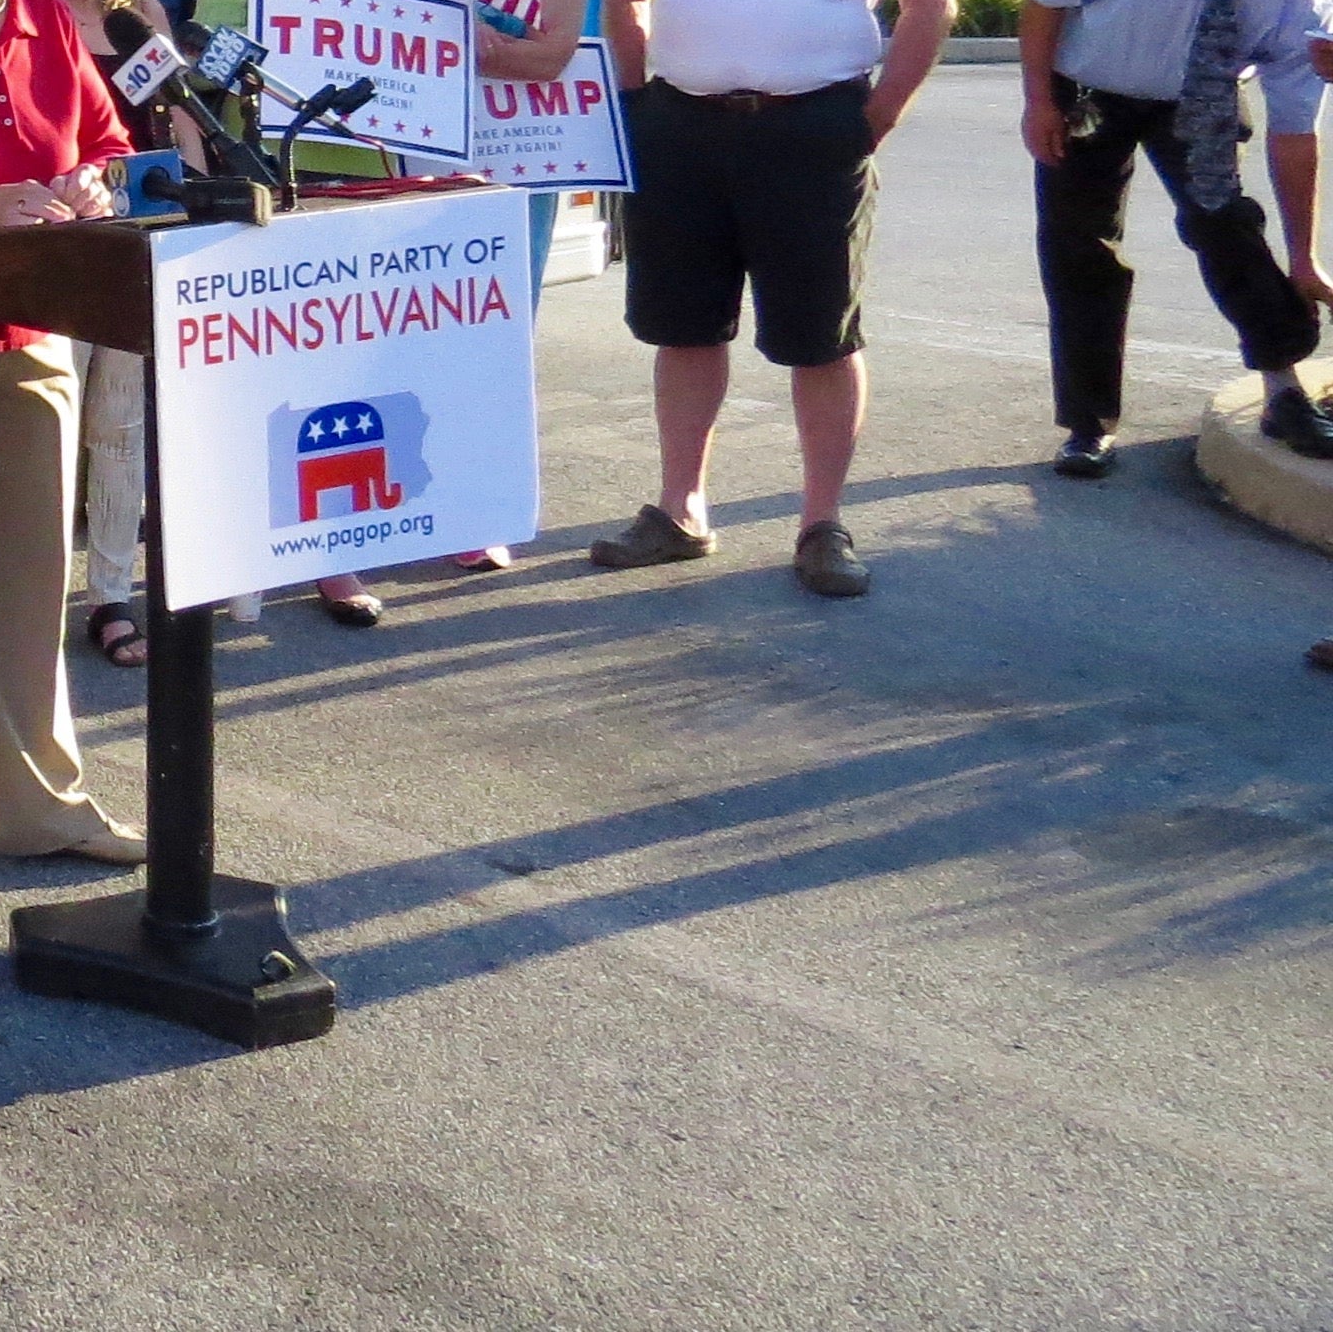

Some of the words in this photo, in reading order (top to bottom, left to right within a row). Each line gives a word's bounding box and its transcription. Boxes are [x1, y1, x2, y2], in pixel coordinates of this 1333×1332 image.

[270, 16, 460, 78] TRUMP
[473, 129, 500, 140] AKE
[503, 125, 563, 140] AMERICA
[473, 144, 509, 157] REAT
[515, 142, 561, 154] AGAIN!
[176, 254, 359, 305] REPUBLICAN
[369, 243, 453, 278] PARTY
[463, 236, 505, 263] OF
[178, 274, 510, 369] PENNSYLVANIA
[270, 513, 433, 557] www.pagop.org
